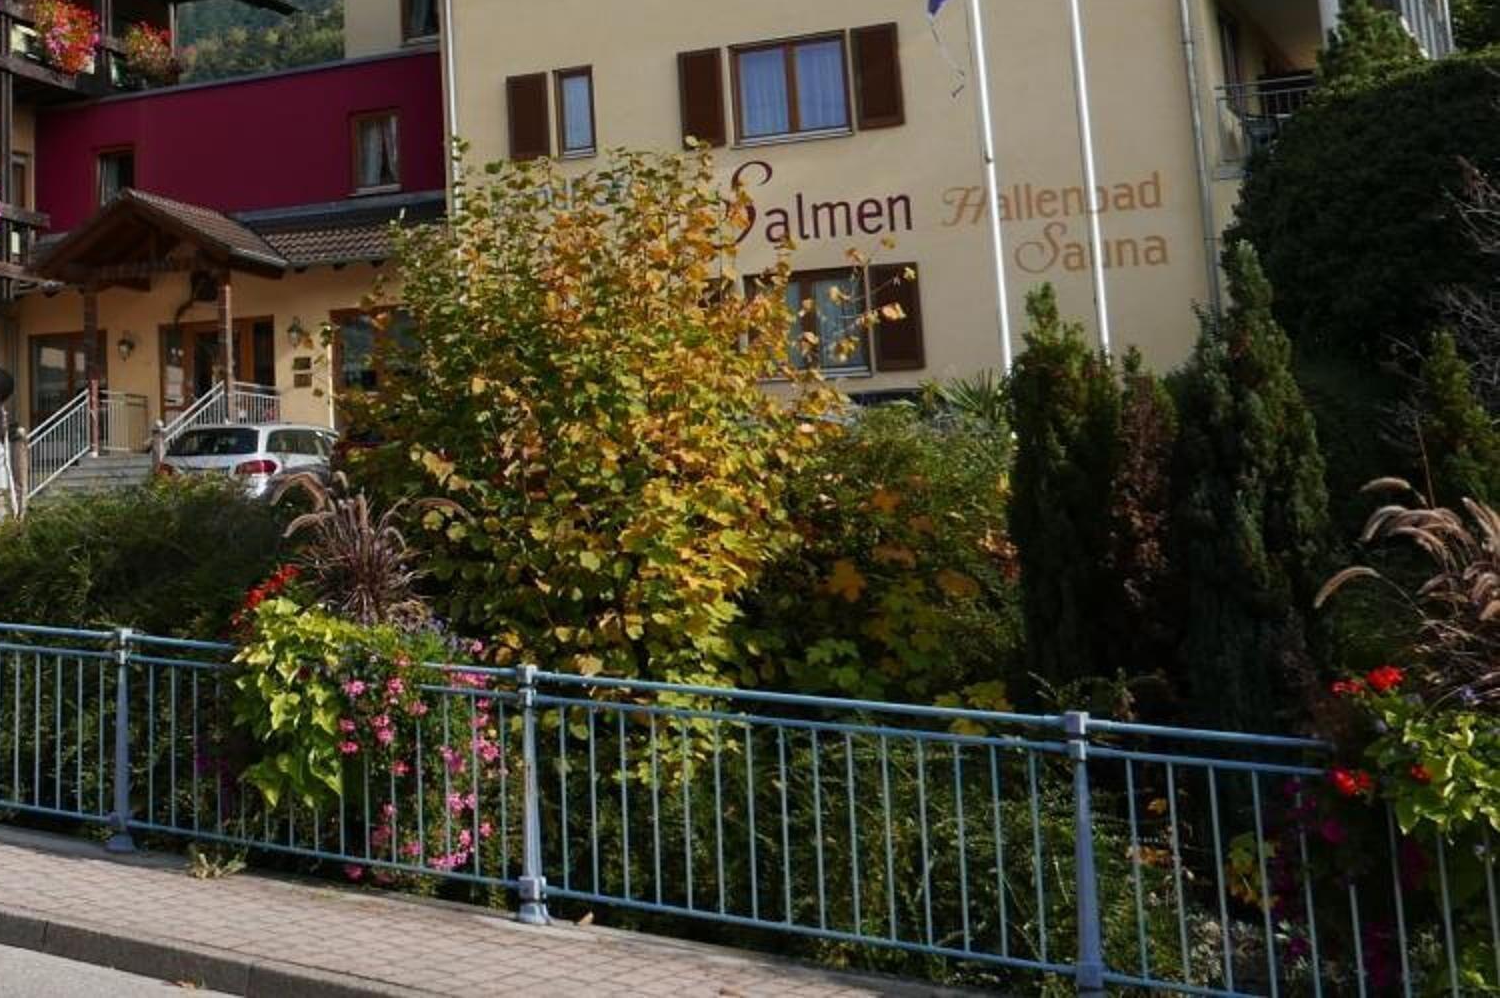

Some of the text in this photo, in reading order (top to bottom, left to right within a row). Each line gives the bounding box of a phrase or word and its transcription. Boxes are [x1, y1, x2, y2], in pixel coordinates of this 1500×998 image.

[712, 161, 912, 251] Salmen
[940, 171, 1164, 228] Hallenbad
[1014, 221, 1170, 274] Sauna
